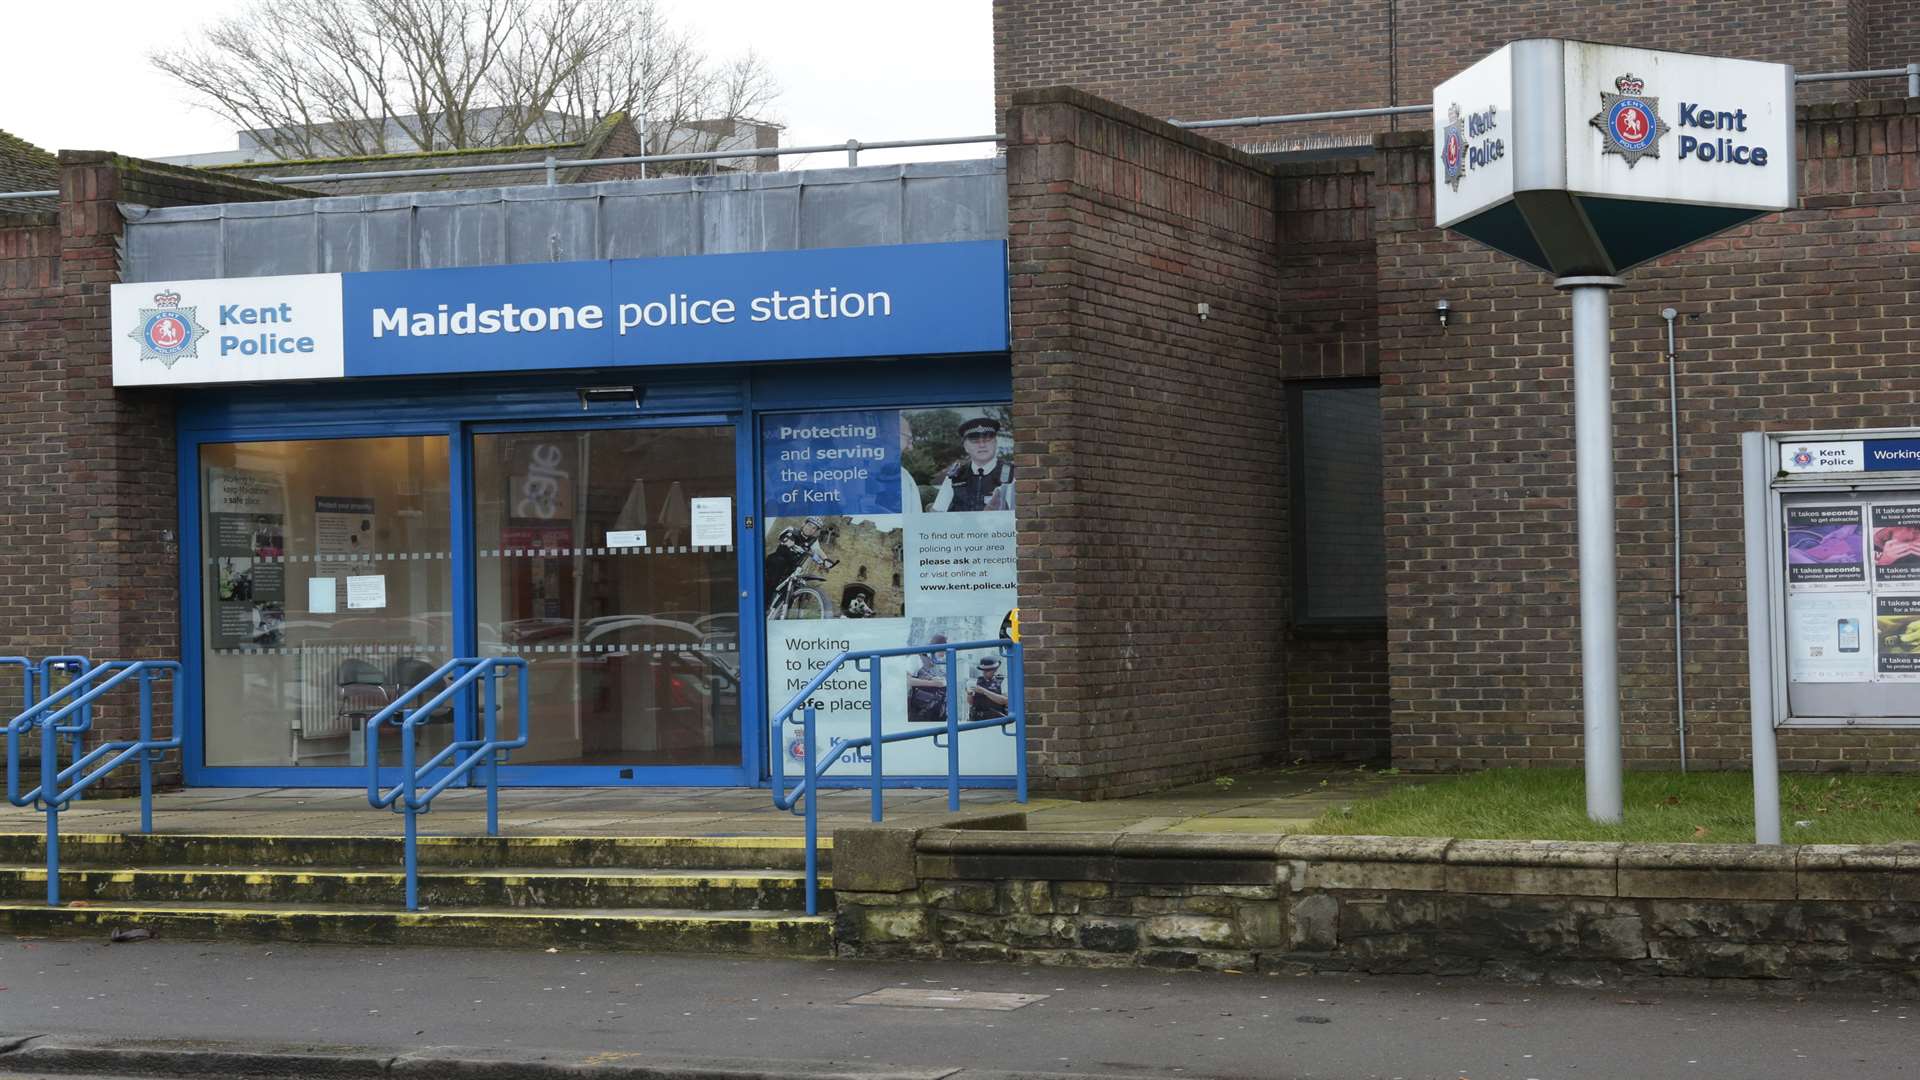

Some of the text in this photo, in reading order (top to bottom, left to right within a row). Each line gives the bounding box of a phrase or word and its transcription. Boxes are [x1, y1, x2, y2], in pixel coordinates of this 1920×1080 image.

[1621, 100, 1644, 108] KENT
[1469, 105, 1497, 138] Kent
[1678, 102, 1747, 131] Kent
[1619, 140, 1647, 149] POLICE
[1678, 135, 1768, 166] Police
[1469, 138, 1504, 169] Police
[219, 302, 292, 325] Kent
[372, 286, 891, 338] Maidstone police station
[220, 334, 314, 356] Police
[780, 425, 876, 439] Protecting
[781, 445, 885, 460] and serving
[781, 467, 868, 483] the people
[782, 489, 840, 503] of Kent
[920, 545, 951, 554] policing
[920, 558, 950, 566] please
[984, 556, 1017, 565] receptio
[920, 582, 1016, 591] www.kent.police.uk
[785, 638, 850, 652] Working
[786, 659, 801, 670] to
[830, 698, 871, 712] place
